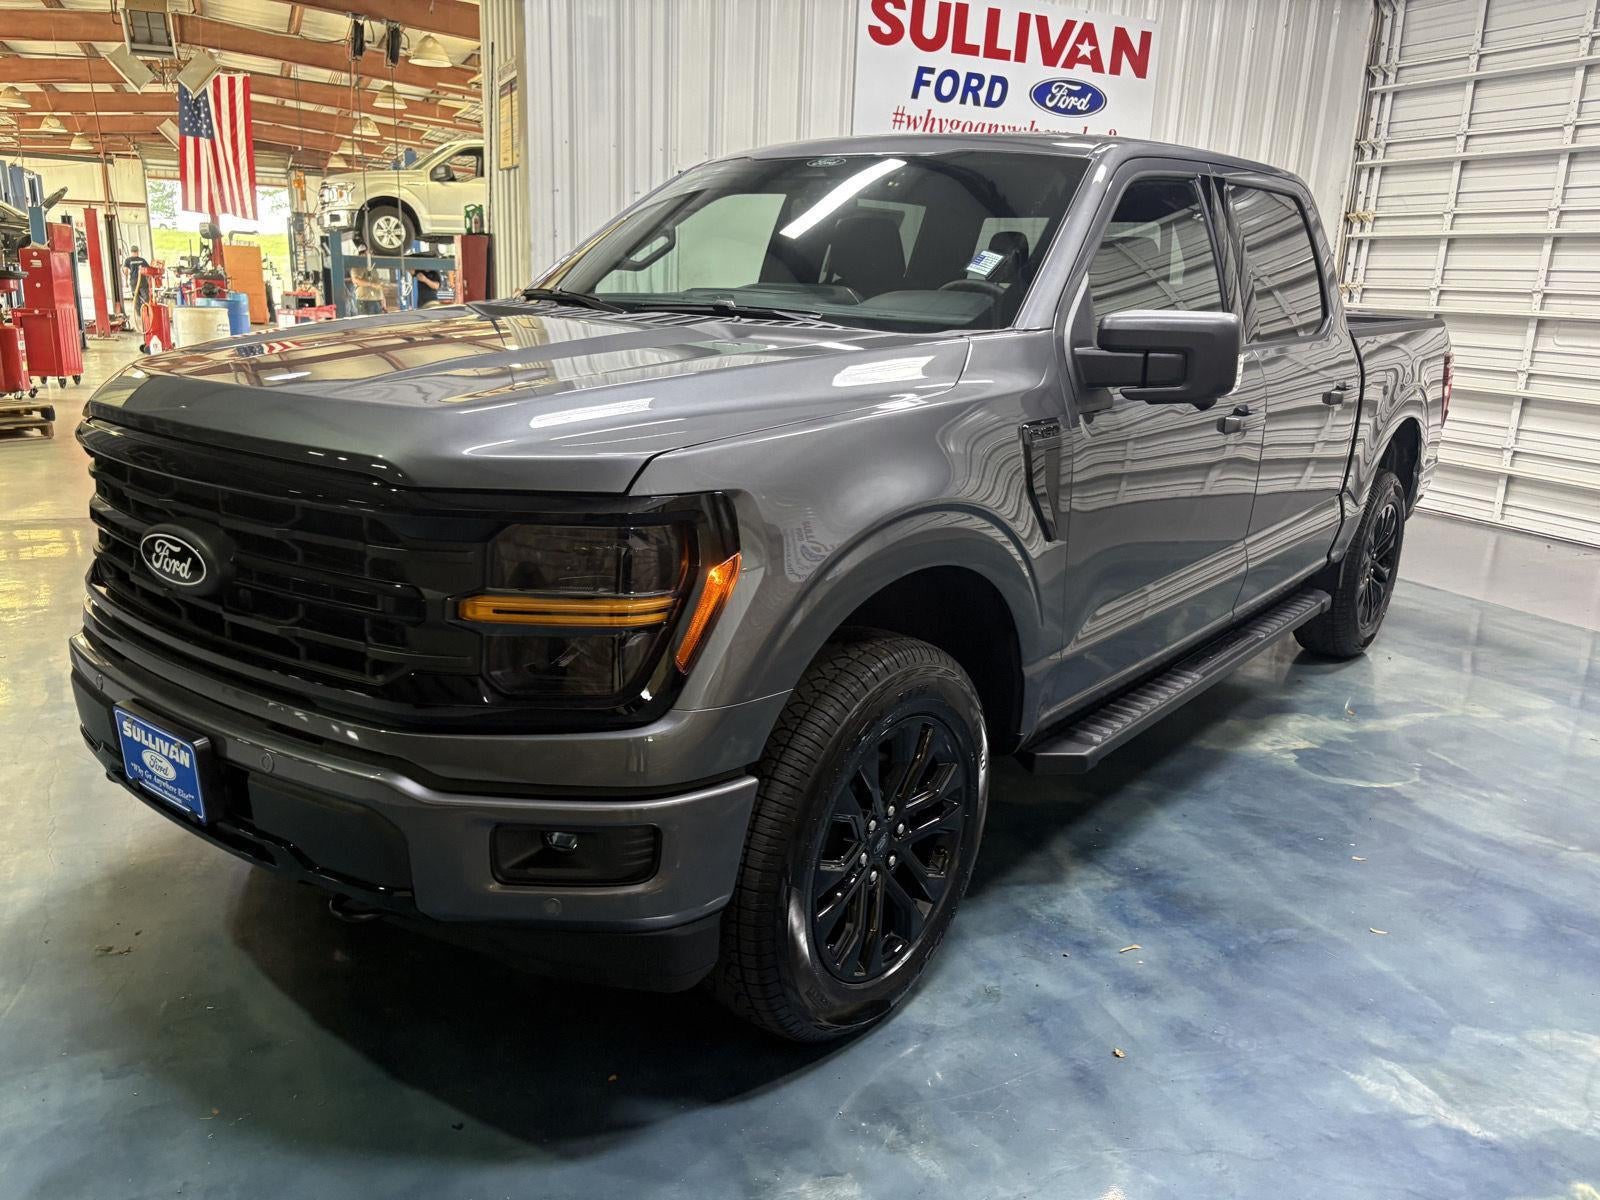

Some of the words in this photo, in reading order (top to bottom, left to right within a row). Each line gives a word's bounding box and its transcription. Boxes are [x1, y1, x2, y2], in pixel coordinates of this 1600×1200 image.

[867, 0, 1152, 80] SULLIVAN
[910, 65, 1009, 109] FORD
[1045, 81, 1091, 112] Ford
[152, 539, 193, 580] Ford
[122, 720, 190, 769] SULLIVAN
[149, 754, 169, 776] Ford
[152, 775, 177, 795] Anywhere
